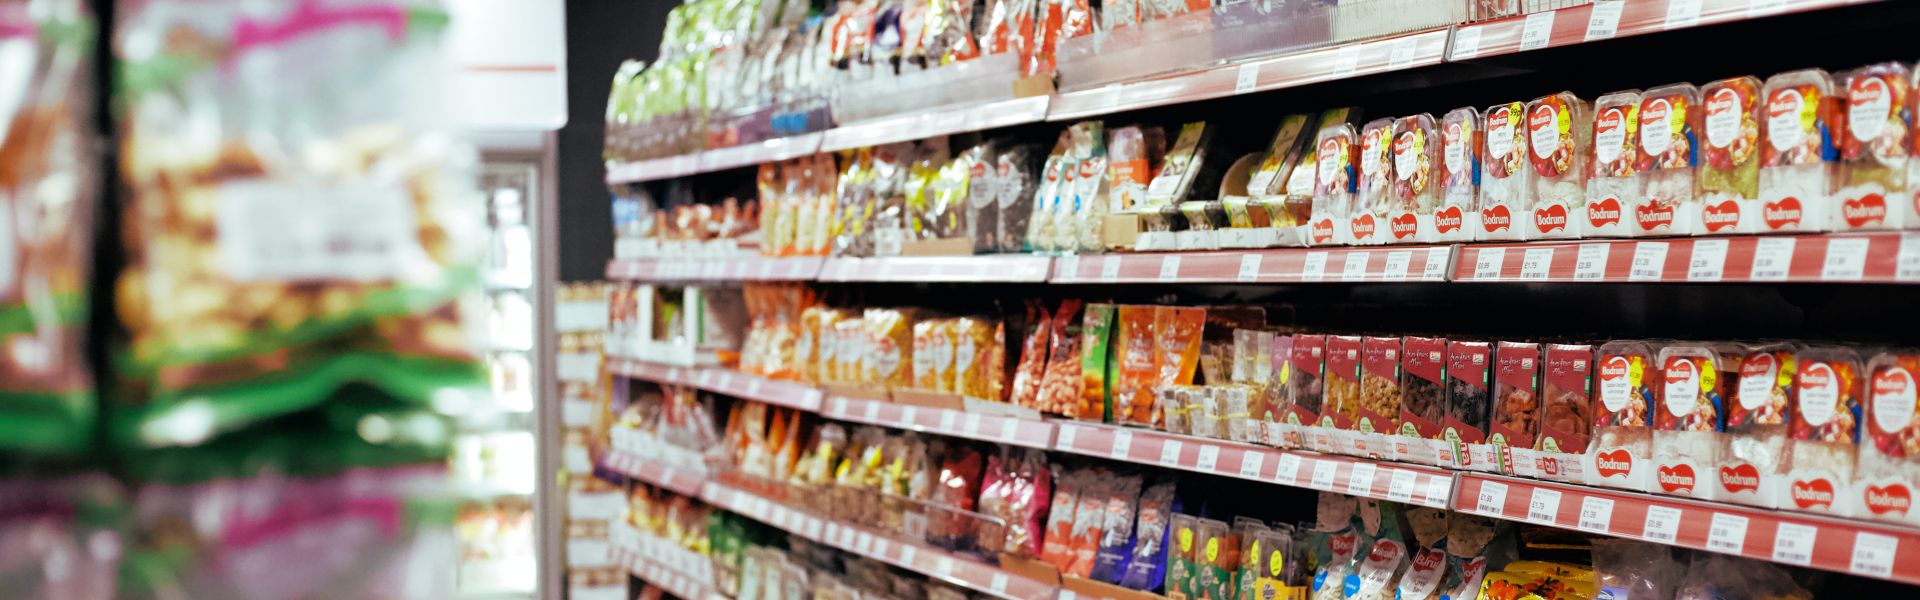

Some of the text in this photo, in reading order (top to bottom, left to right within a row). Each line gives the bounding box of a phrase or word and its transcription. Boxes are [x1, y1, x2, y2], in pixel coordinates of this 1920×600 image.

[1510, 108, 1520, 118] 99p
[1590, 207, 1619, 220] Bodrum
[1639, 210, 1671, 223] Bodrum
[1705, 210, 1738, 222] Bodrum
[1767, 207, 1801, 220] Bodrum
[1846, 205, 1884, 218] Bodrum
[1437, 214, 1460, 227] Bodrum
[1483, 213, 1509, 225] Bodrum
[1537, 213, 1565, 225] Bodrum
[1313, 225, 1333, 236] Bodrum
[1353, 222, 1374, 233] Bodrum
[1392, 220, 1416, 232] Bodrum
[1602, 366, 1625, 376] Bodrum
[1667, 368, 1690, 378] Bodrum
[1598, 458, 1630, 471] Bodrum
[1660, 472, 1693, 486] Bodrum
[1722, 472, 1758, 487] Bodrum
[1795, 486, 1832, 501] Bodrum
[1869, 491, 1909, 507] Bodrum
